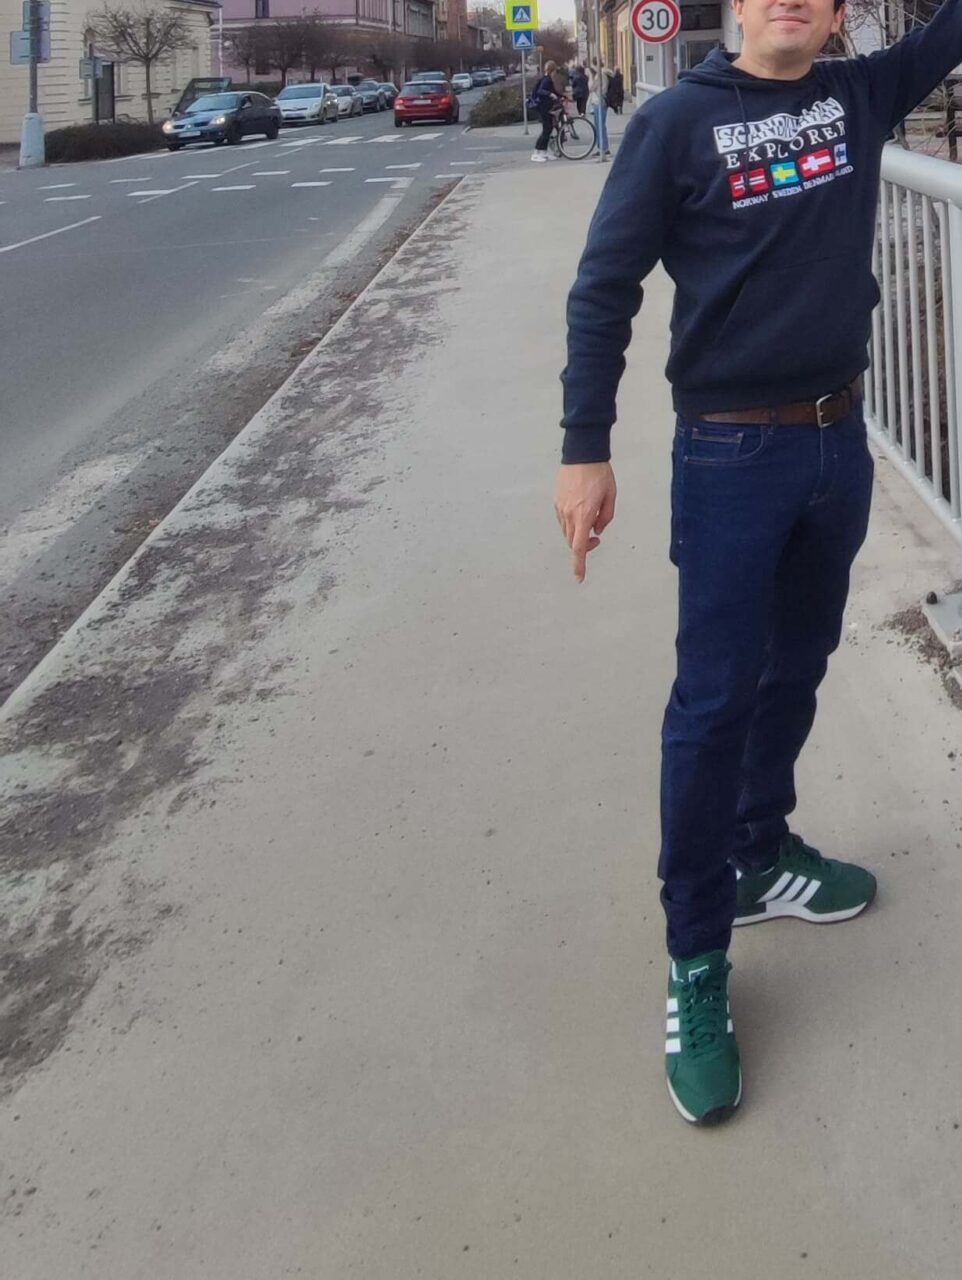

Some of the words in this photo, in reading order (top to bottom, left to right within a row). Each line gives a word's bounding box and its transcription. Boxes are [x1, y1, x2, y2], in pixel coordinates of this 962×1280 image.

[641, 8, 670, 31] 30
[725, 120, 846, 169] EXPLORER
[732, 192, 769, 210] NORWAY
[802, 172, 836, 190] DENMAR
